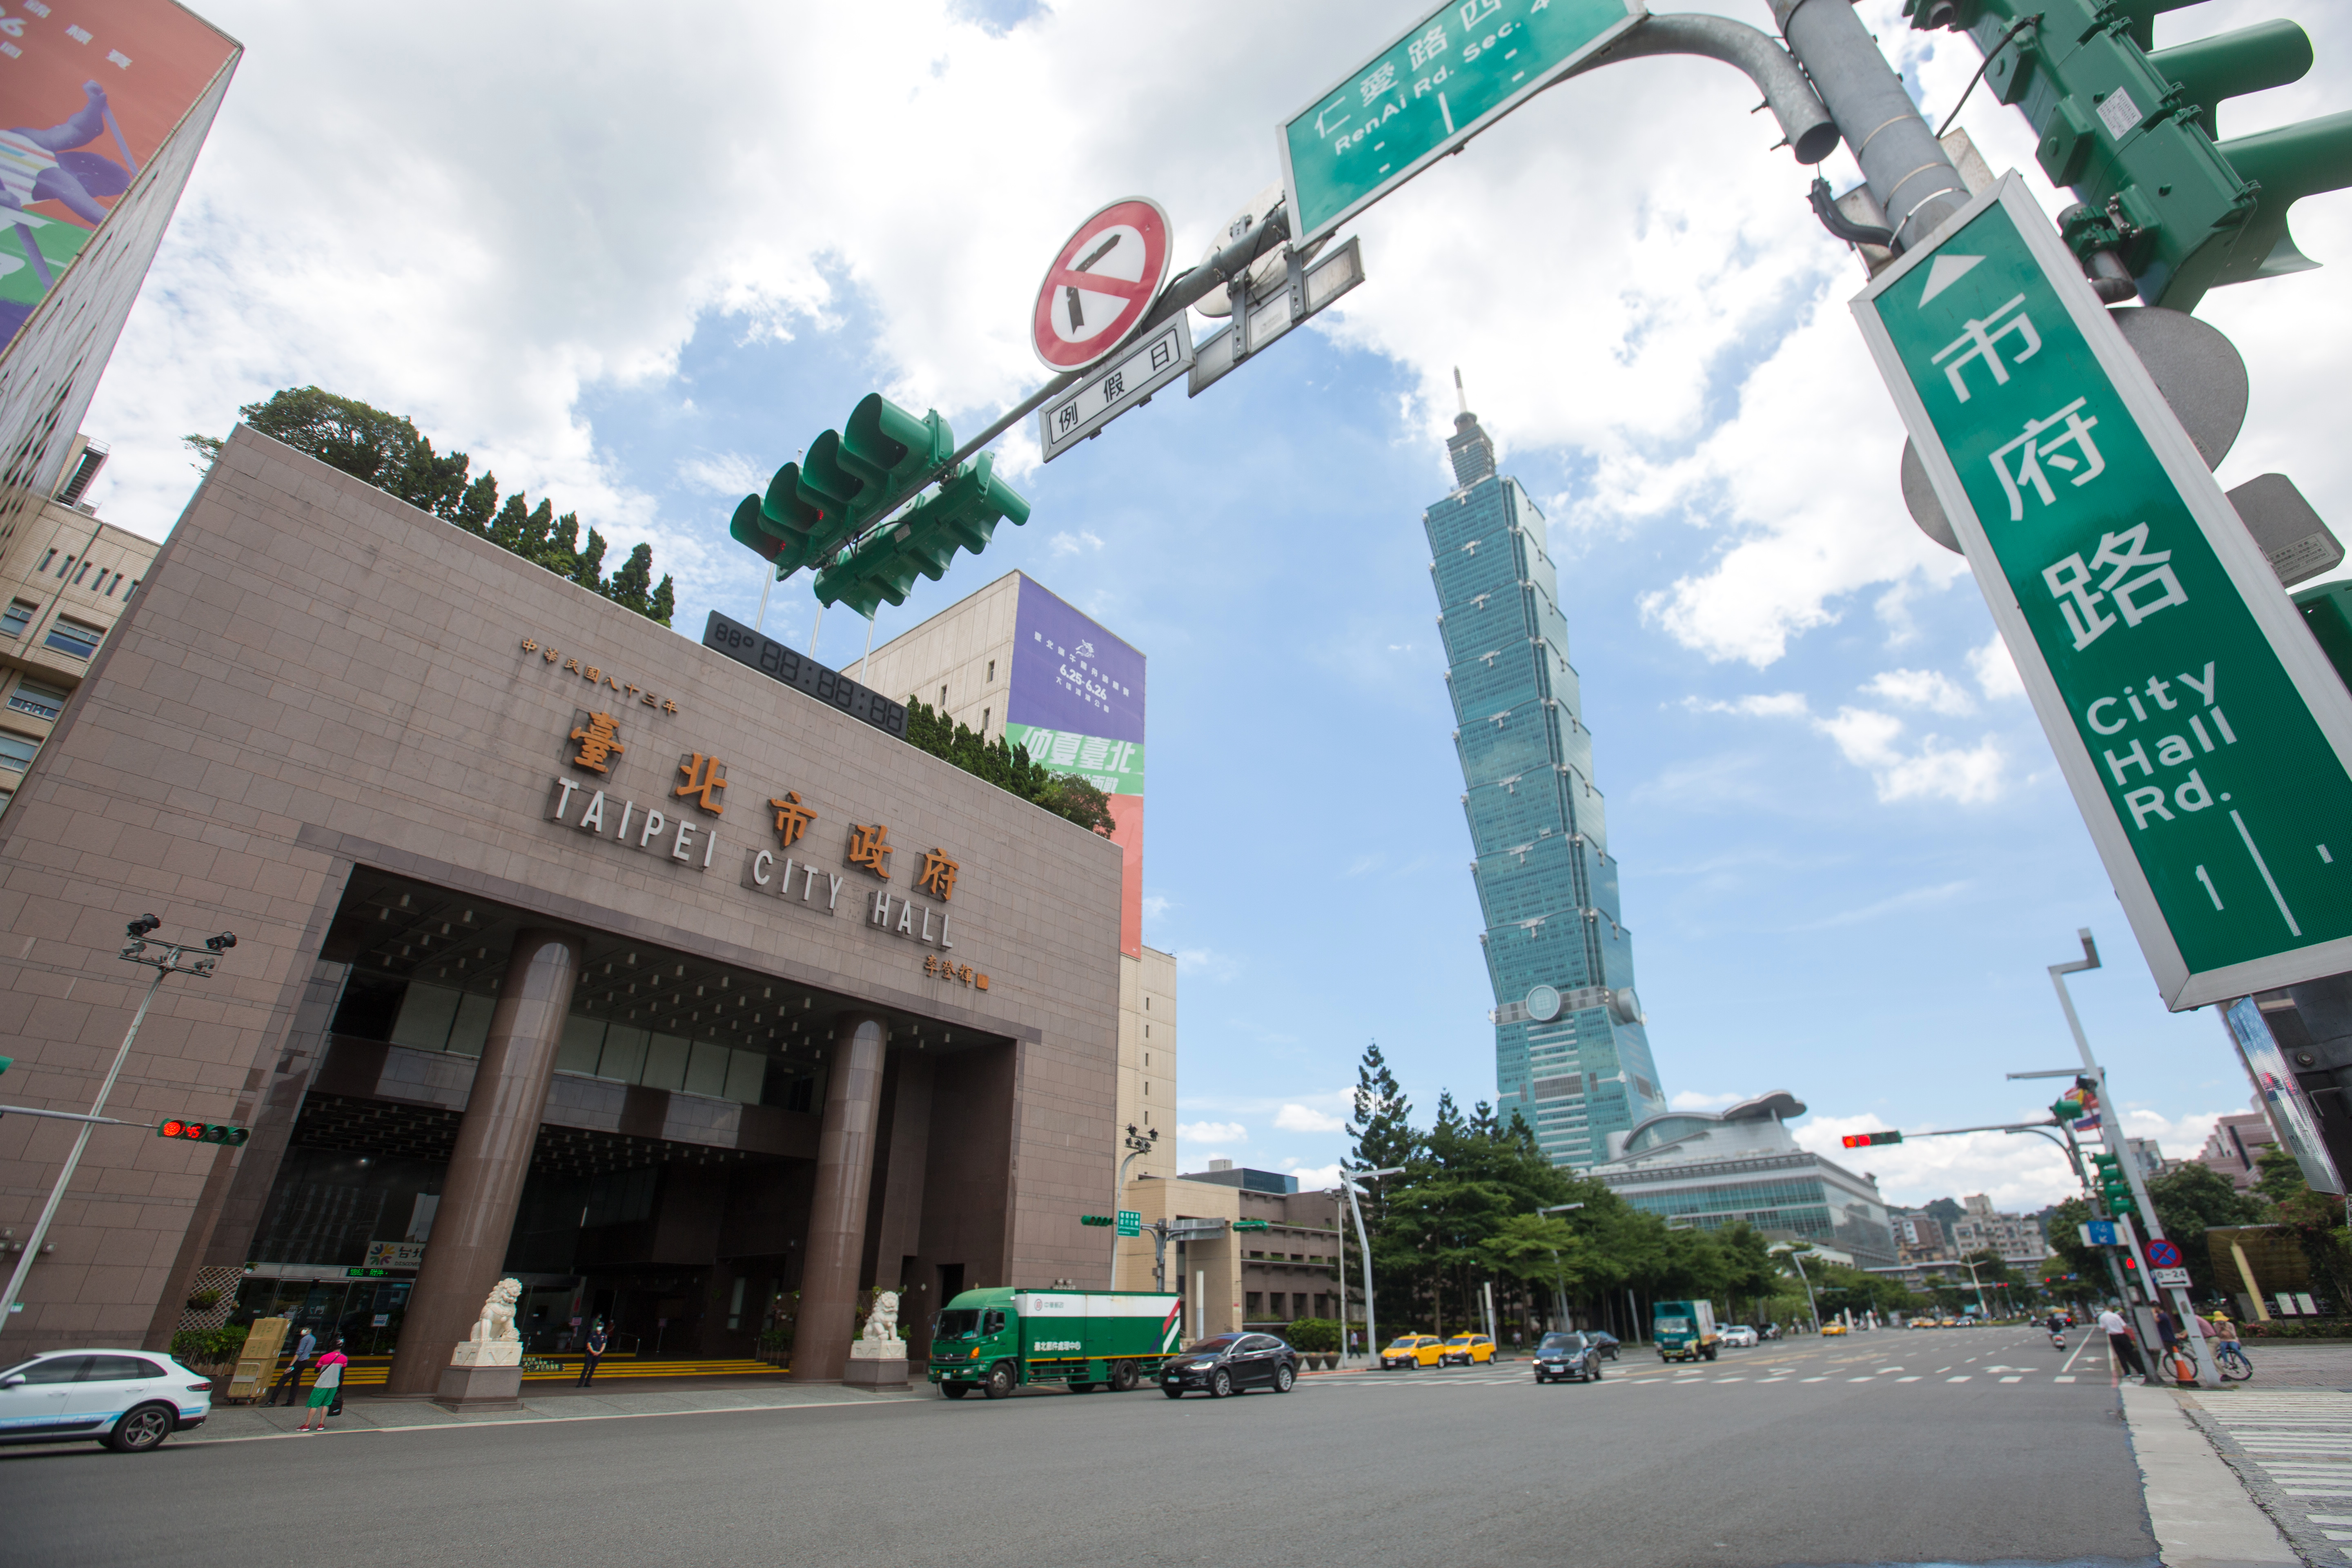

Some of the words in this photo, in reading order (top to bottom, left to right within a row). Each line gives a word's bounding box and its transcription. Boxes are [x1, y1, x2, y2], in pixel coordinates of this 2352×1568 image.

[1335, 96, 1407, 156] RenAi
[1414, 60, 1455, 99] Rd.
[1463, 21, 1521, 63] Sec.
[1058, 341, 1171, 434] 例假日
[1931, 292, 2189, 652] 市府路
[521, 638, 678, 716] 中華民國八十三年
[1059, 664, 1107, 700] 6.25-6.26
[2087, 660, 2215, 736] City
[1019, 726, 1136, 773] 仲夏臺北
[2103, 706, 2237, 786] Hall
[570, 711, 960, 902] 臺北市政府
[2123, 768, 2231, 831] Rd.
[555, 777, 716, 868] TAIPEI
[752, 849, 844, 909] CITY
[873, 890, 953, 949] HALL
[2195, 864, 2224, 911] 1
[924, 954, 973, 988] 李登輝
